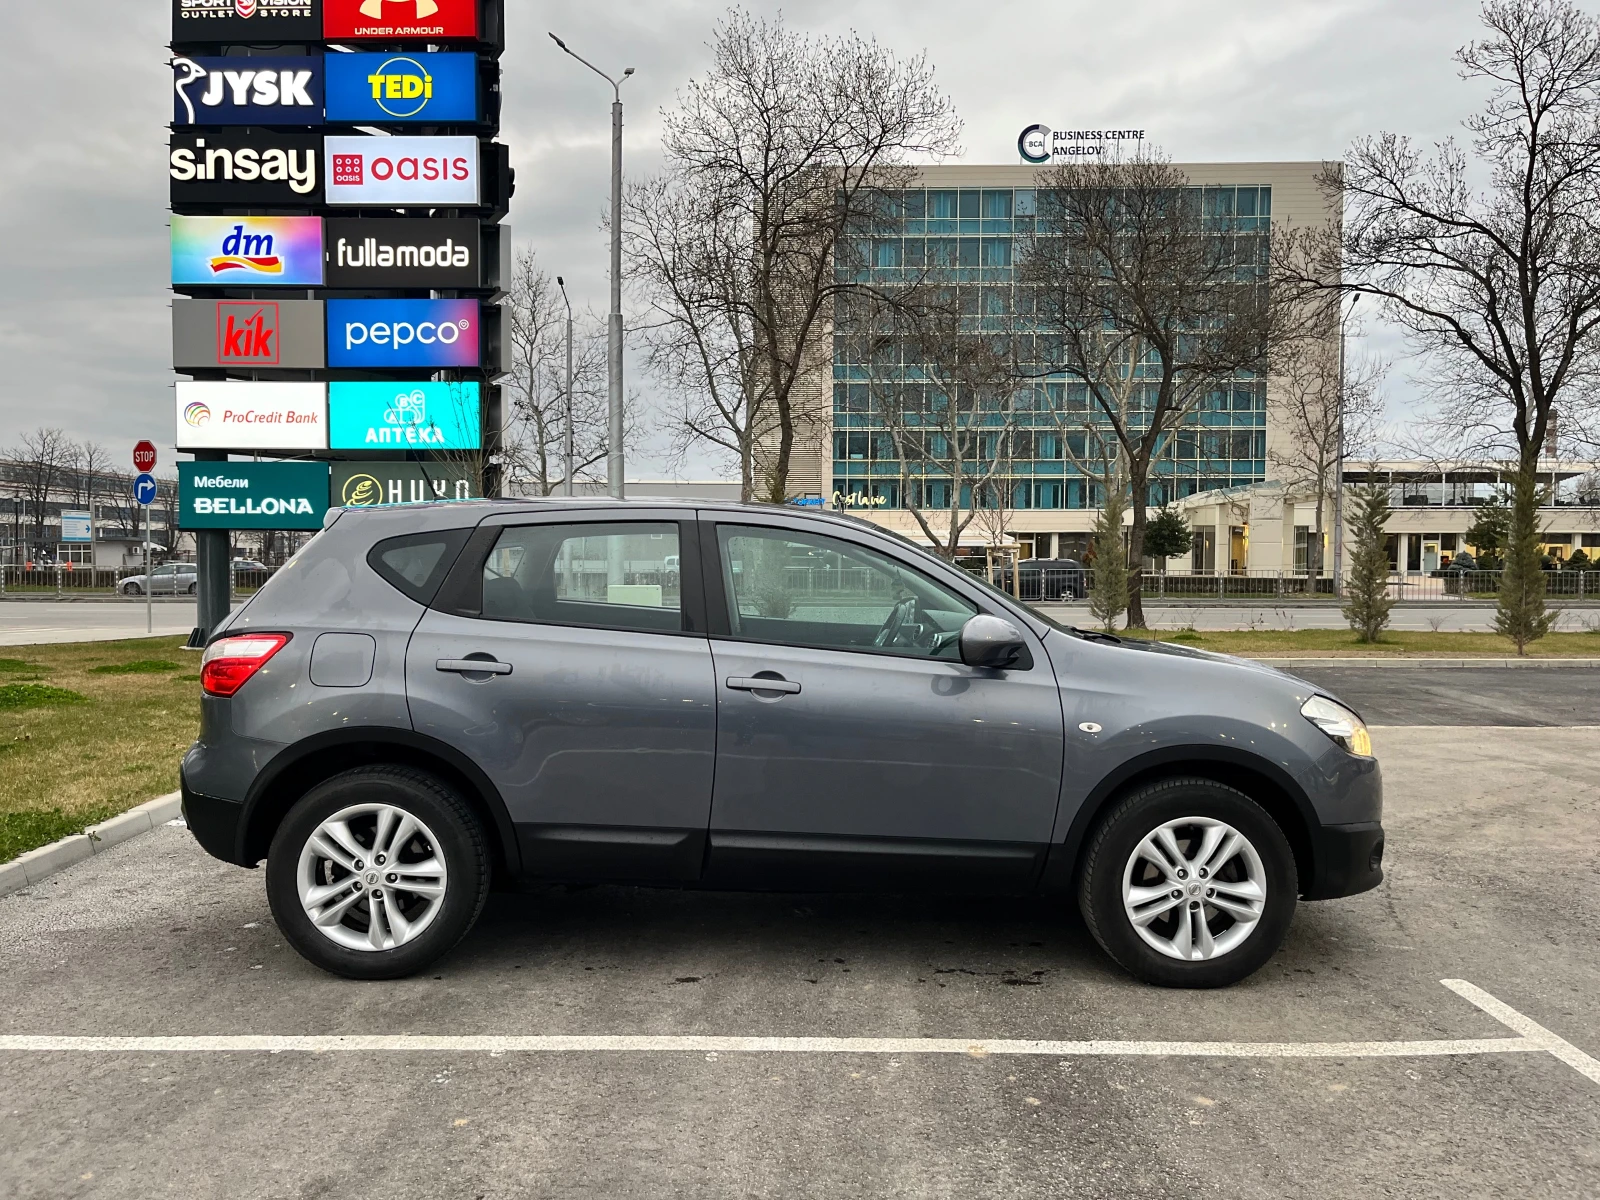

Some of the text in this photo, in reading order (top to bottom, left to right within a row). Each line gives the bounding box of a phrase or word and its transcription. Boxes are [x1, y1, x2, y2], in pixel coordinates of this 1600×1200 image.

[181, 9, 311, 18] OUTLET STORE
[354, 26, 444, 35] UNDER ARMOUR
[201, 71, 314, 106] JYSK
[368, 74, 432, 99] TEDi
[1053, 129, 1145, 141] BUSINESS CENTRE
[1028, 140, 1043, 148] BCA
[1052, 145, 1102, 156] ANGELOV
[170, 138, 315, 194] sinsay
[222, 226, 273, 256] dm
[338, 238, 470, 267] fullamoda
[346, 321, 459, 350] pepco
[223, 410, 318, 424] ProCredit Bank
[365, 427, 445, 443] АПТЕКА
[135, 451, 154, 463] STOP
[194, 476, 248, 489] Мебели
[194, 498, 313, 514] BELLONA
